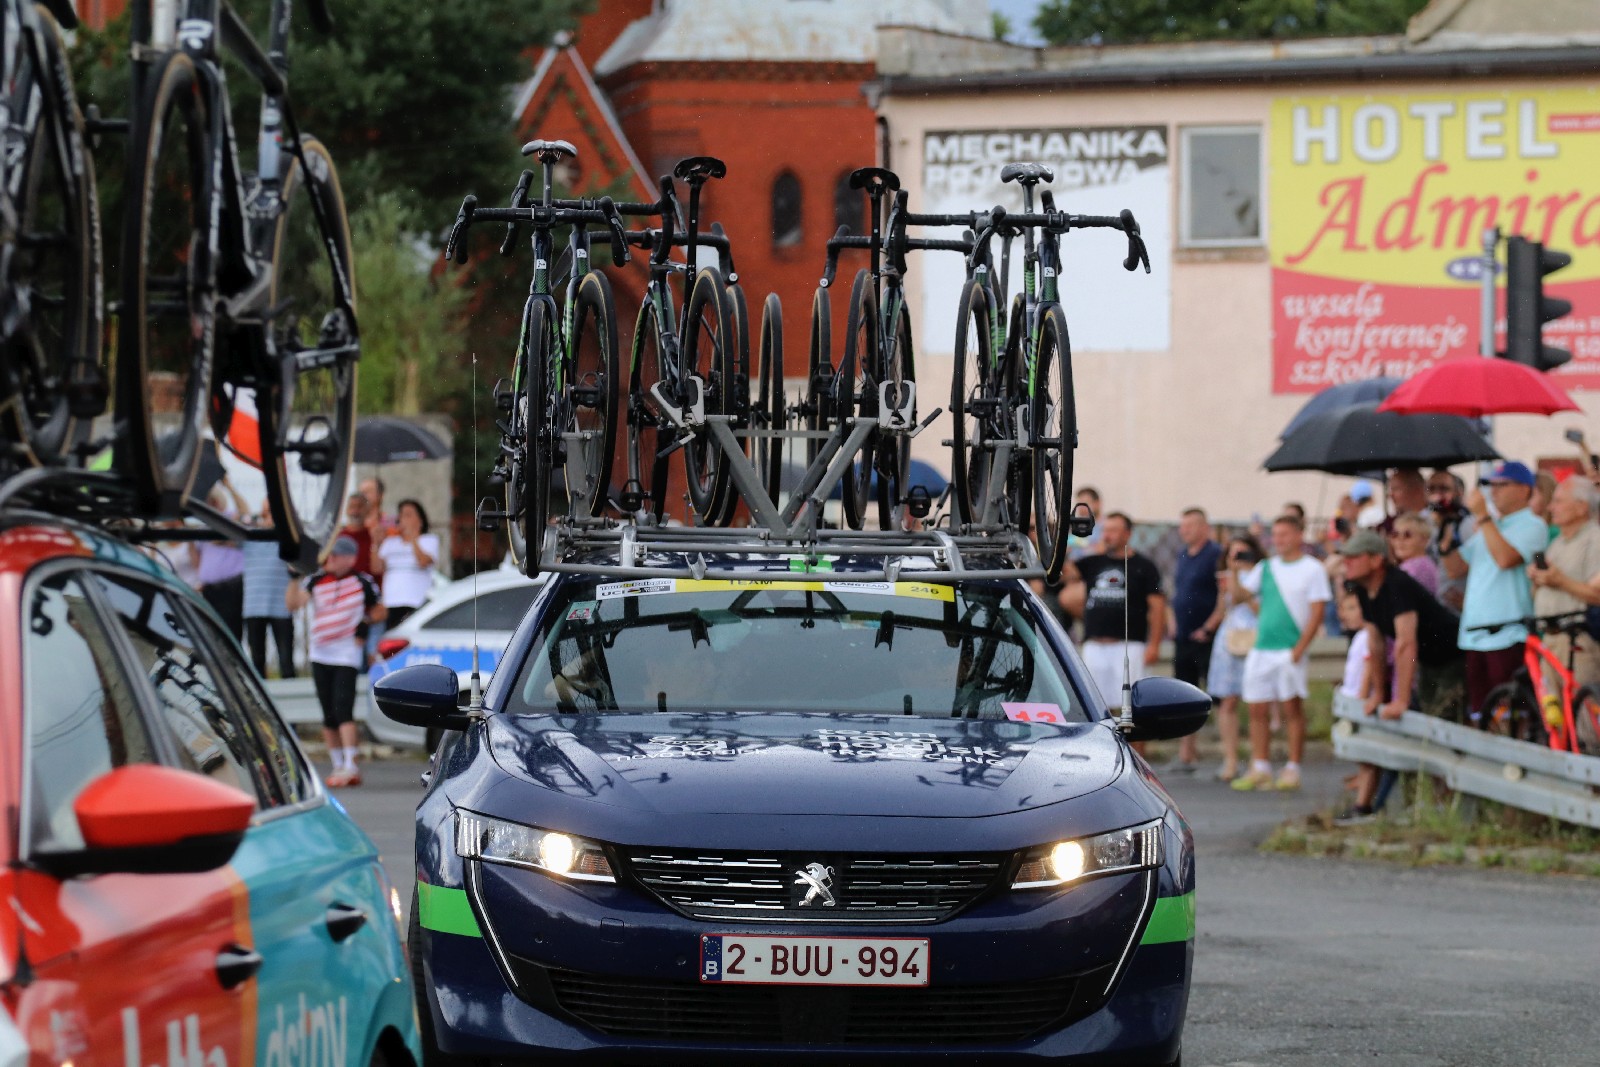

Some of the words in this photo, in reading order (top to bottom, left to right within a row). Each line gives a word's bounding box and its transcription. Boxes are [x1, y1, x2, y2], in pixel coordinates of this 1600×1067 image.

[925, 130, 1167, 162] MECHANIKA
[1293, 99, 1560, 165] HOTEL
[1294, 315, 1468, 358] konferencje
[818, 735, 941, 743] novo
[705, 960, 718, 975] B
[726, 943, 920, 977] 2-BUU-994
